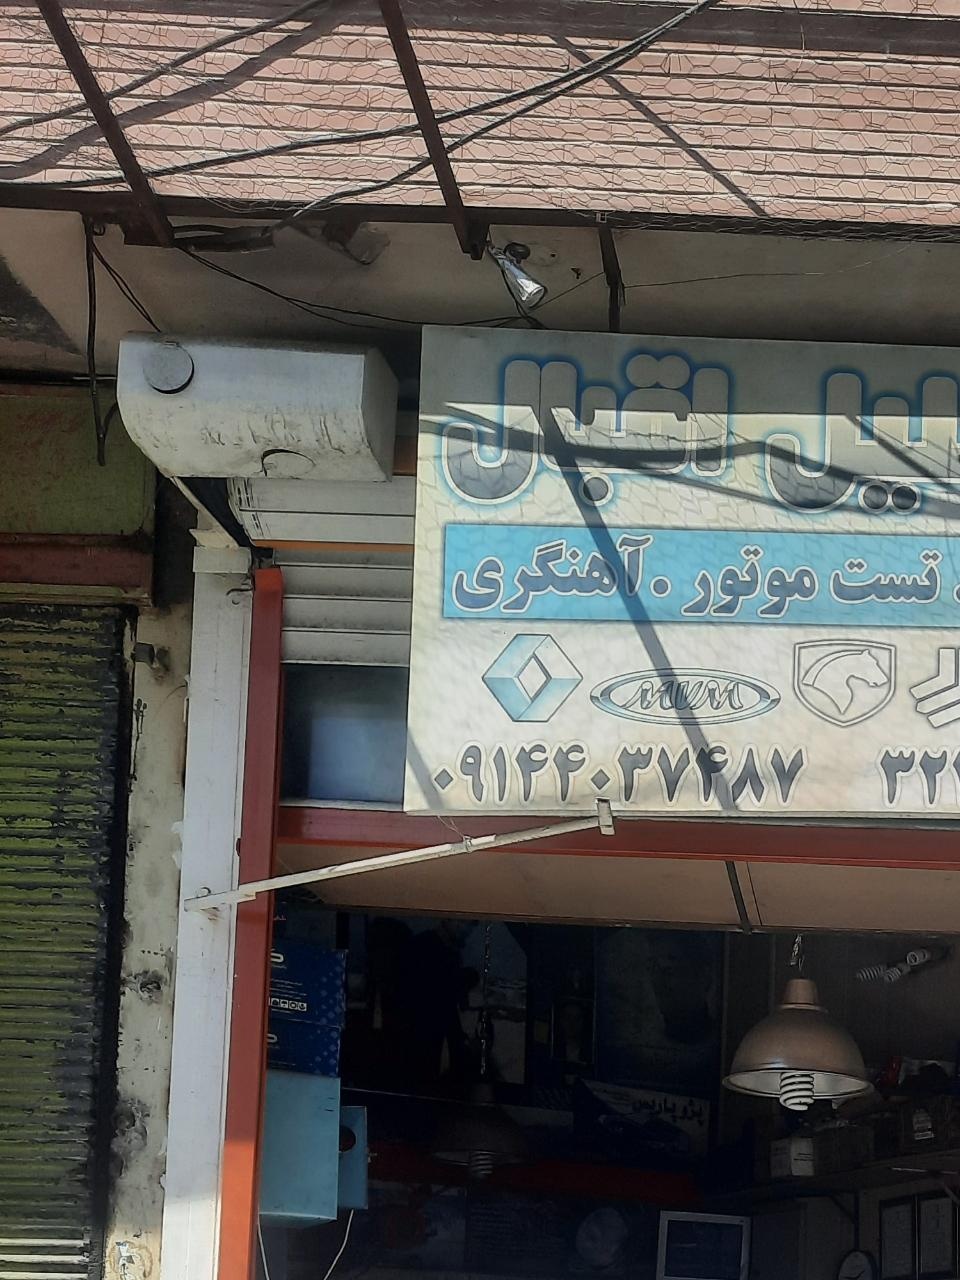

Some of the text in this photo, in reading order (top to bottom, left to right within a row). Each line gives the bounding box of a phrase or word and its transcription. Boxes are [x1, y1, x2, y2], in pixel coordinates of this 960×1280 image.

[442, 353, 730, 504] اقبال
[452, 535, 653, 613] آهنگری
[681, 544, 819, 618] موتور
[831, 550, 943, 604] تست
[434, 743, 805, 806] ۰۹۱۴۴۰۳۷۴۸۷
